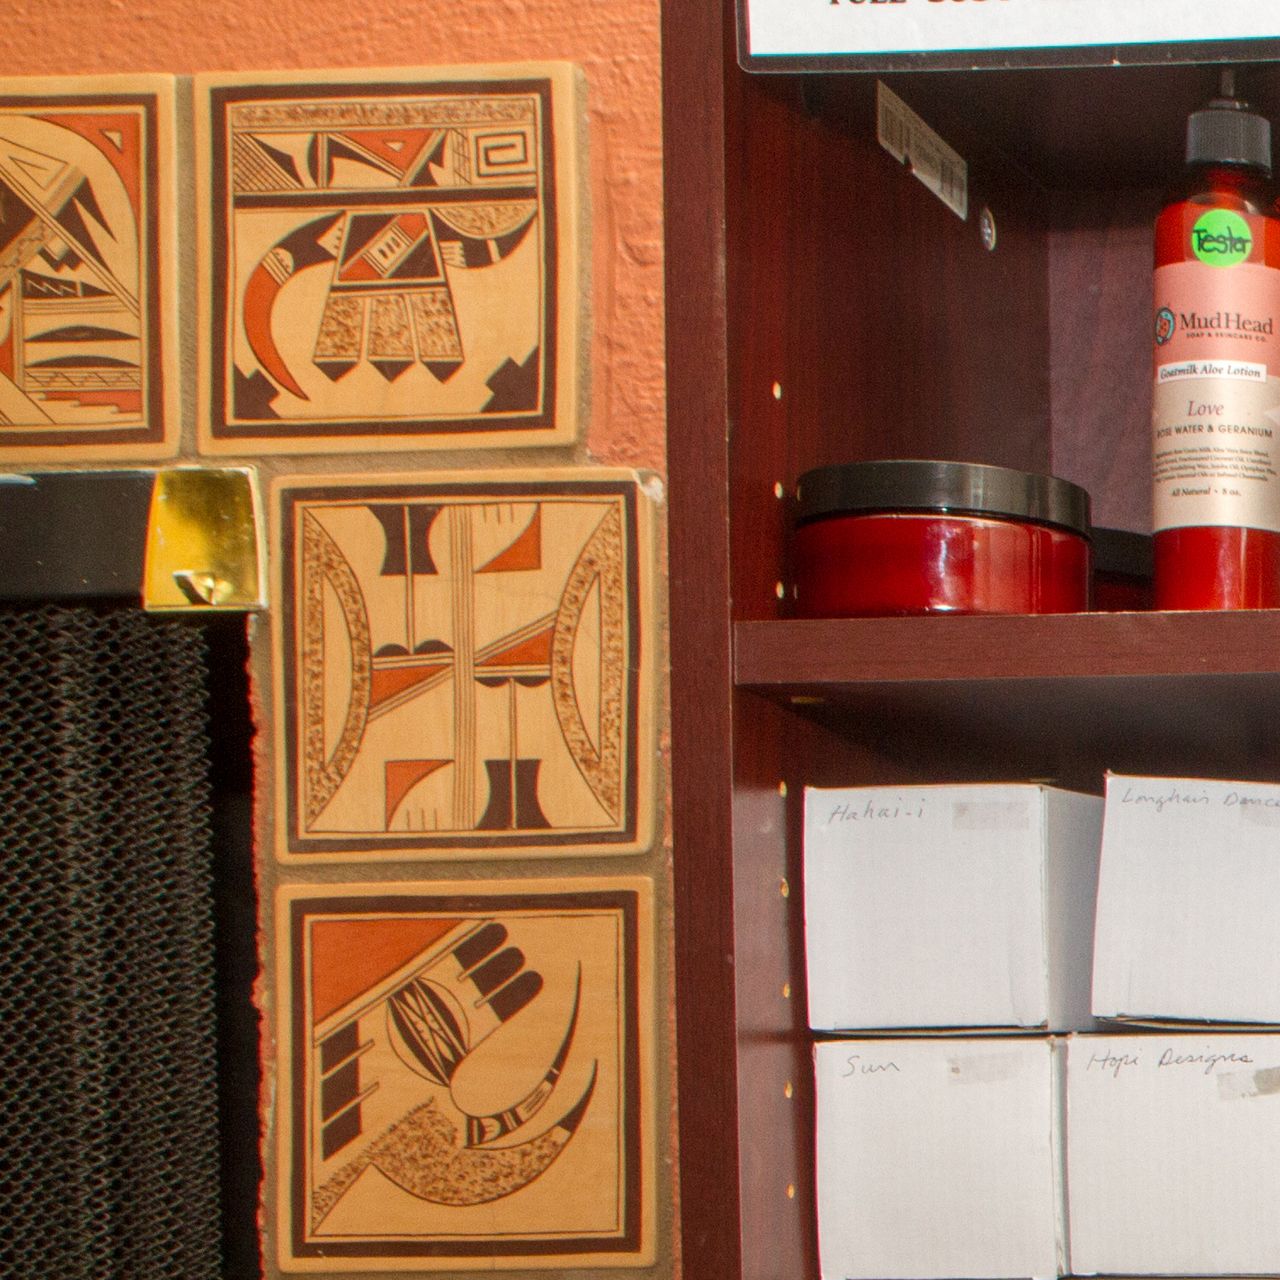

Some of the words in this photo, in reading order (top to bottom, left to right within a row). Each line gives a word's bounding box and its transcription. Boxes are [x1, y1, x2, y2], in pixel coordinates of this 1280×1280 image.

[1200, 364, 1224, 375] Aloe
[1227, 365, 1261, 378] Lotion
[1187, 400, 1225, 417] Love
[1175, 424, 1204, 435] WATER
[1218, 424, 1273, 438] GERANIUM
[842, 1055, 902, 1078] Sun
[1087, 1051, 1140, 1072] Hopi
[1158, 1051, 1256, 1072] Designs
